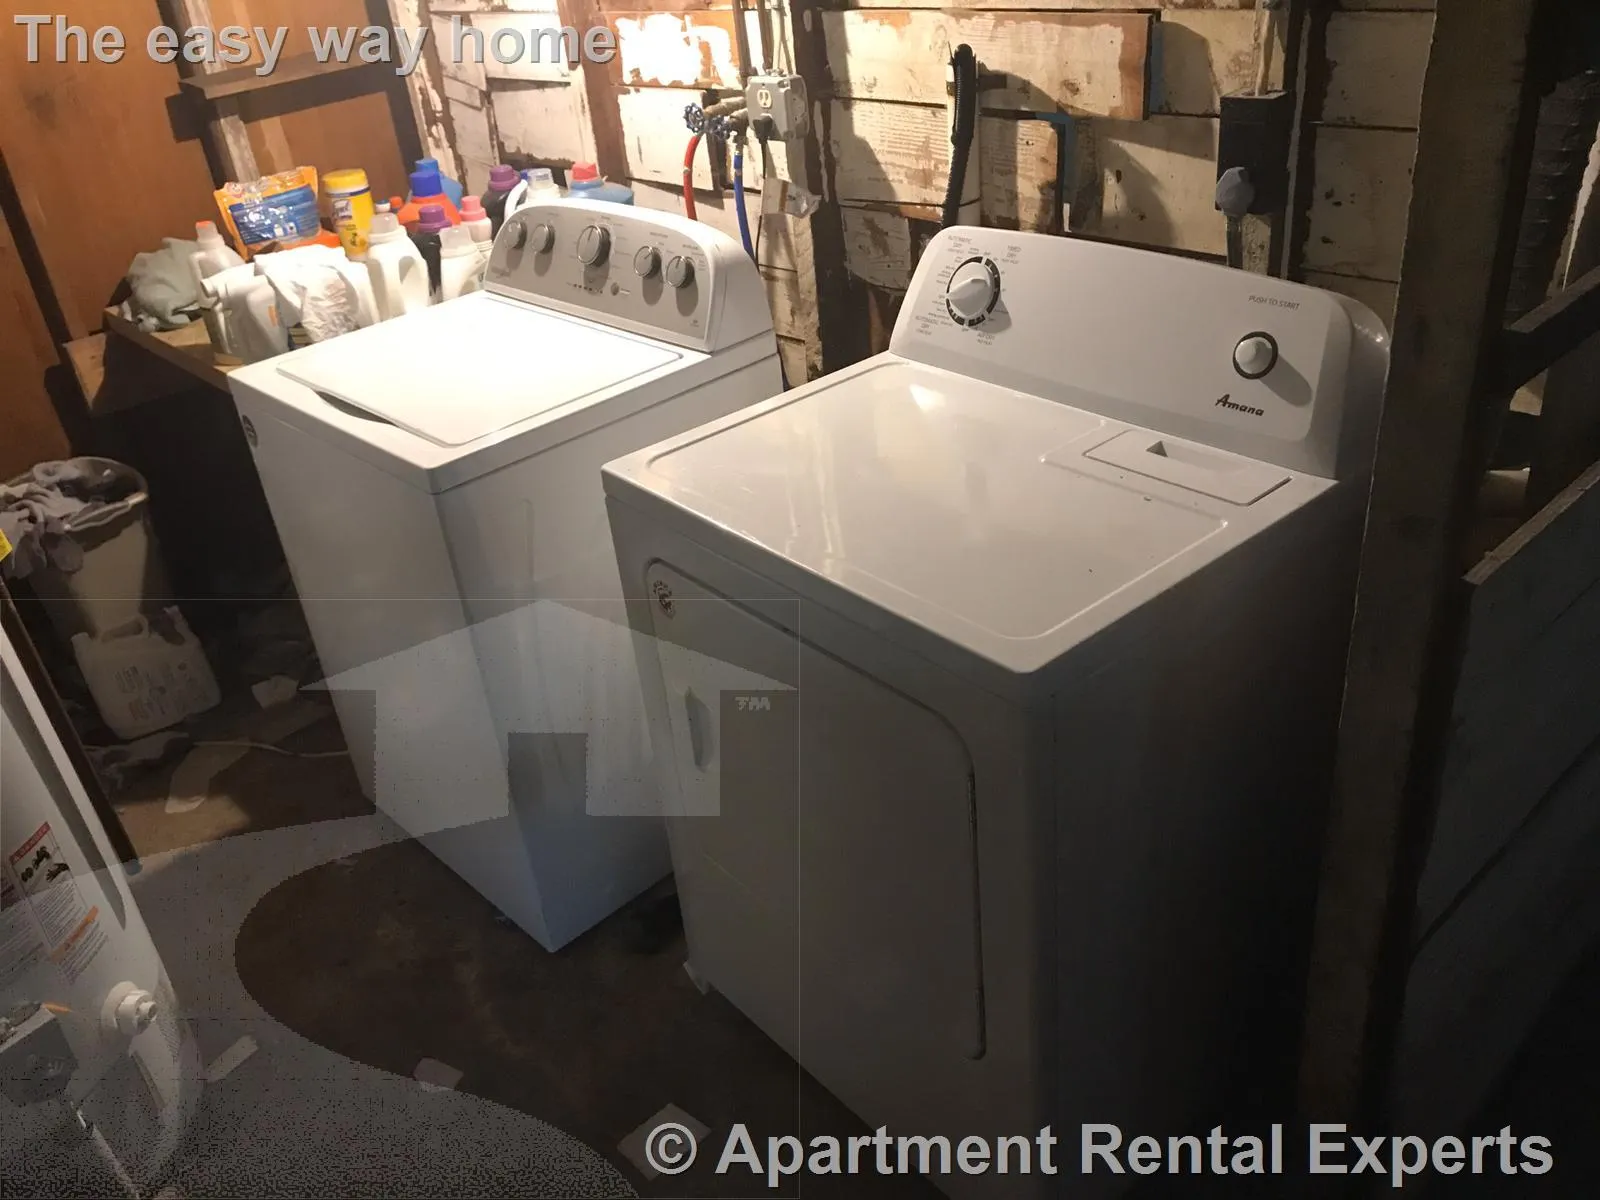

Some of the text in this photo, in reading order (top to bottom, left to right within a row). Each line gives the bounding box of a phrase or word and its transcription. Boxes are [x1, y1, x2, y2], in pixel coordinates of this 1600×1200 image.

[1248, 295, 1300, 310] PUSH TO START
[1215, 393, 1265, 417] Amana
